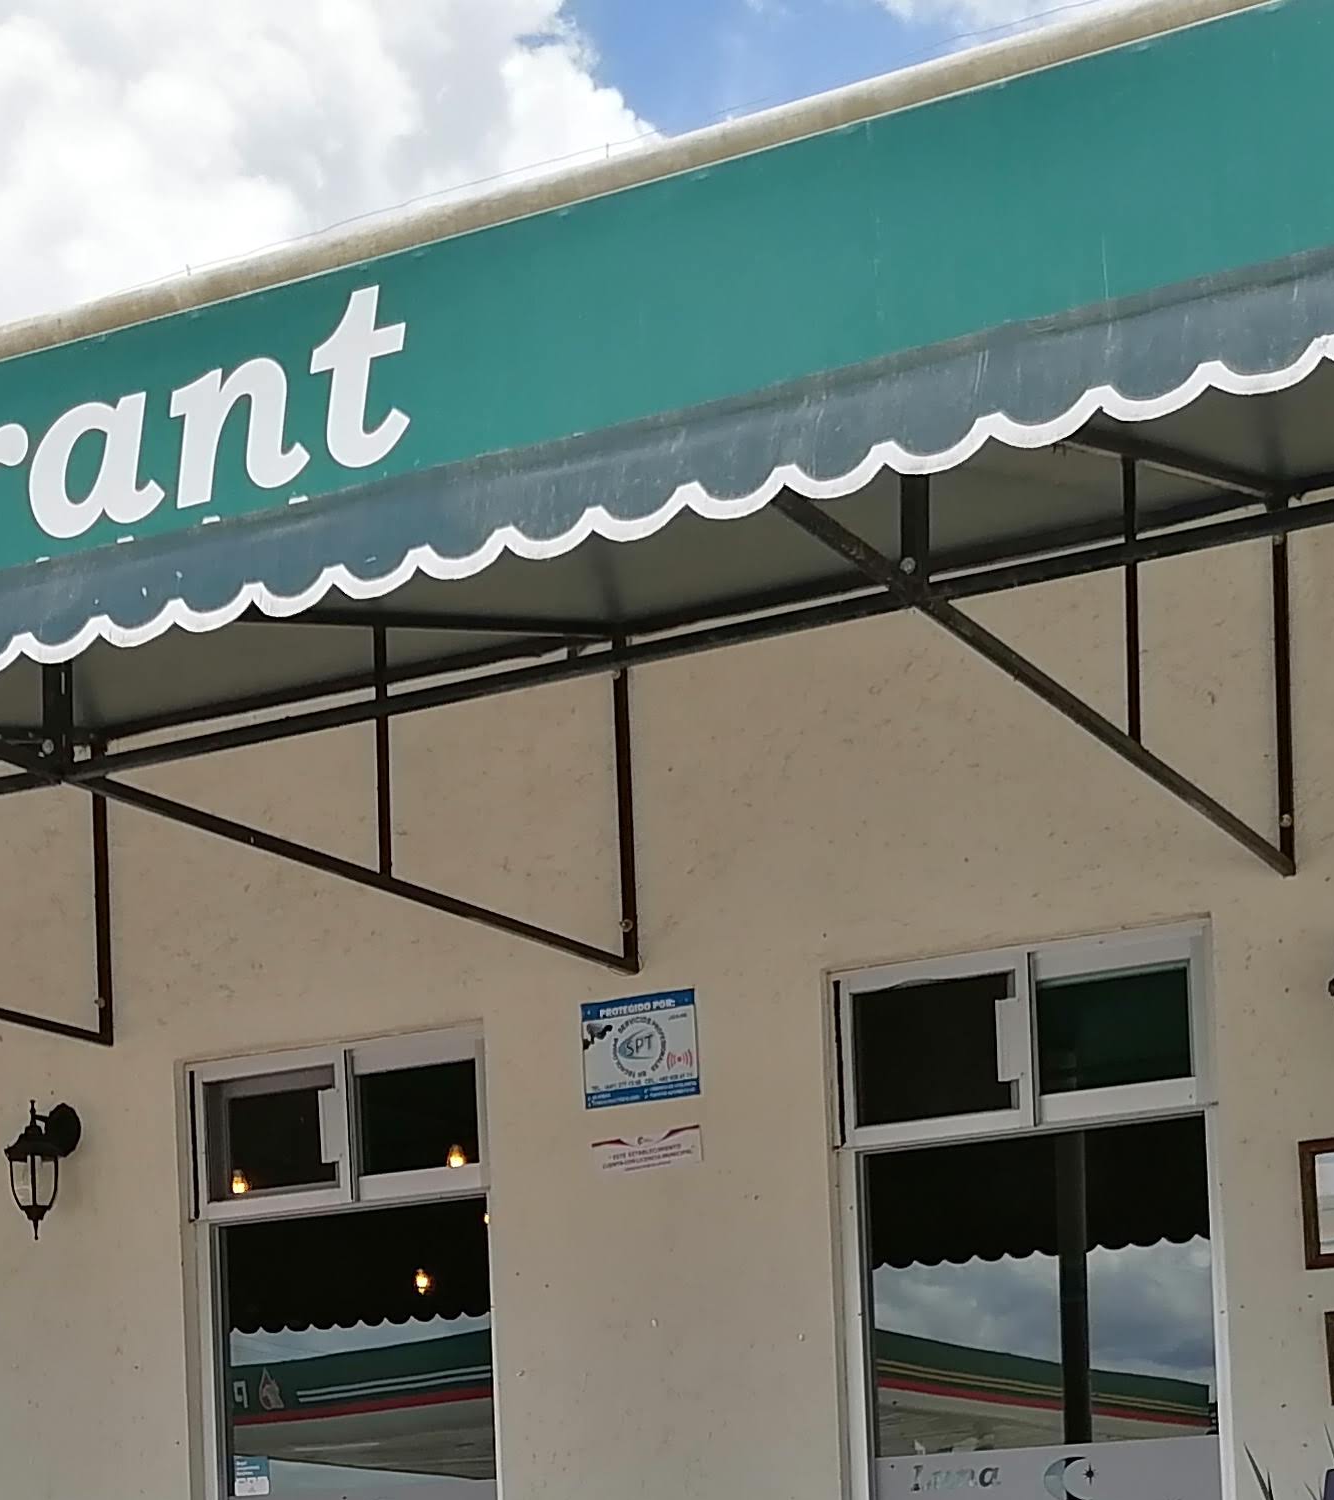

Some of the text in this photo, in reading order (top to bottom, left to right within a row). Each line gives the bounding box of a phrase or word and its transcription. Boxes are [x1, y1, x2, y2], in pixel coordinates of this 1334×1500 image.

[599, 1002, 651, 1018] PROTEGIDO
[626, 1033, 654, 1057] SPT
[911, 1464, 1001, 1492] Luna
